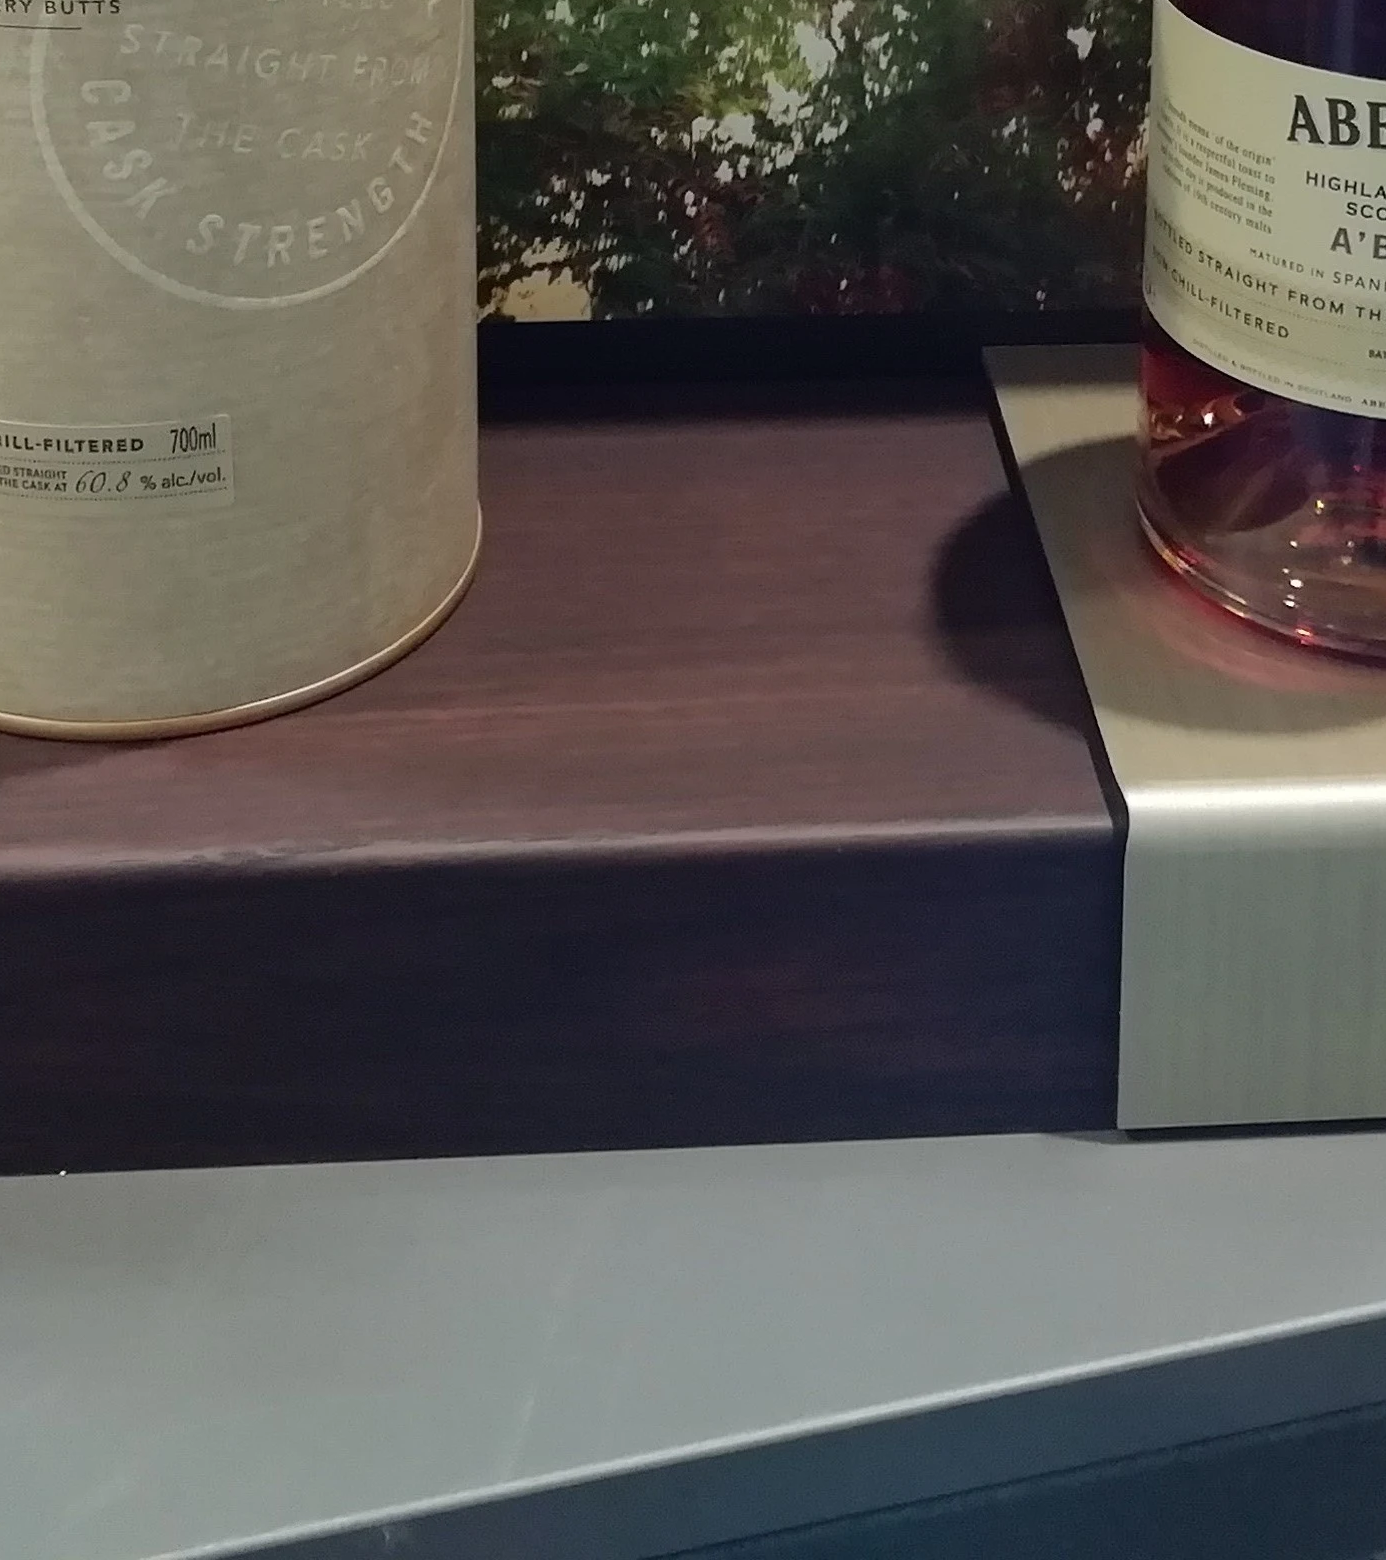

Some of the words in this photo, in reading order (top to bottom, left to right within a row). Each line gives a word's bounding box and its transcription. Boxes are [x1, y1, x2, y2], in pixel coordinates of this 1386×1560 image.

[45, 0, 121, 15] BUTTS
[119, 23, 338, 85] STRAIGHT
[81, 78, 178, 220] CASK
[184, 111, 434, 269] STRENGTH
[1265, 174, 1275, 184] to
[1258, 205, 1272, 217] the
[1154, 211, 1192, 255] BOTTLED
[1198, 250, 1279, 295] STRAIGHT
[1288, 290, 1344, 315] FROM
[1249, 248, 1304, 273] MATURED
[1311, 268, 1324, 279] IN
[1171, 269, 1289, 338] CHILL-FILTERED
[170, 422, 216, 454] 700ml
[13, 467, 67, 480] STRAIGHT
[22, 480, 51, 491] CASK
[54, 483, 67, 492] AT
[76, 470, 131, 493] 60.8
[140, 475, 157, 490] %
